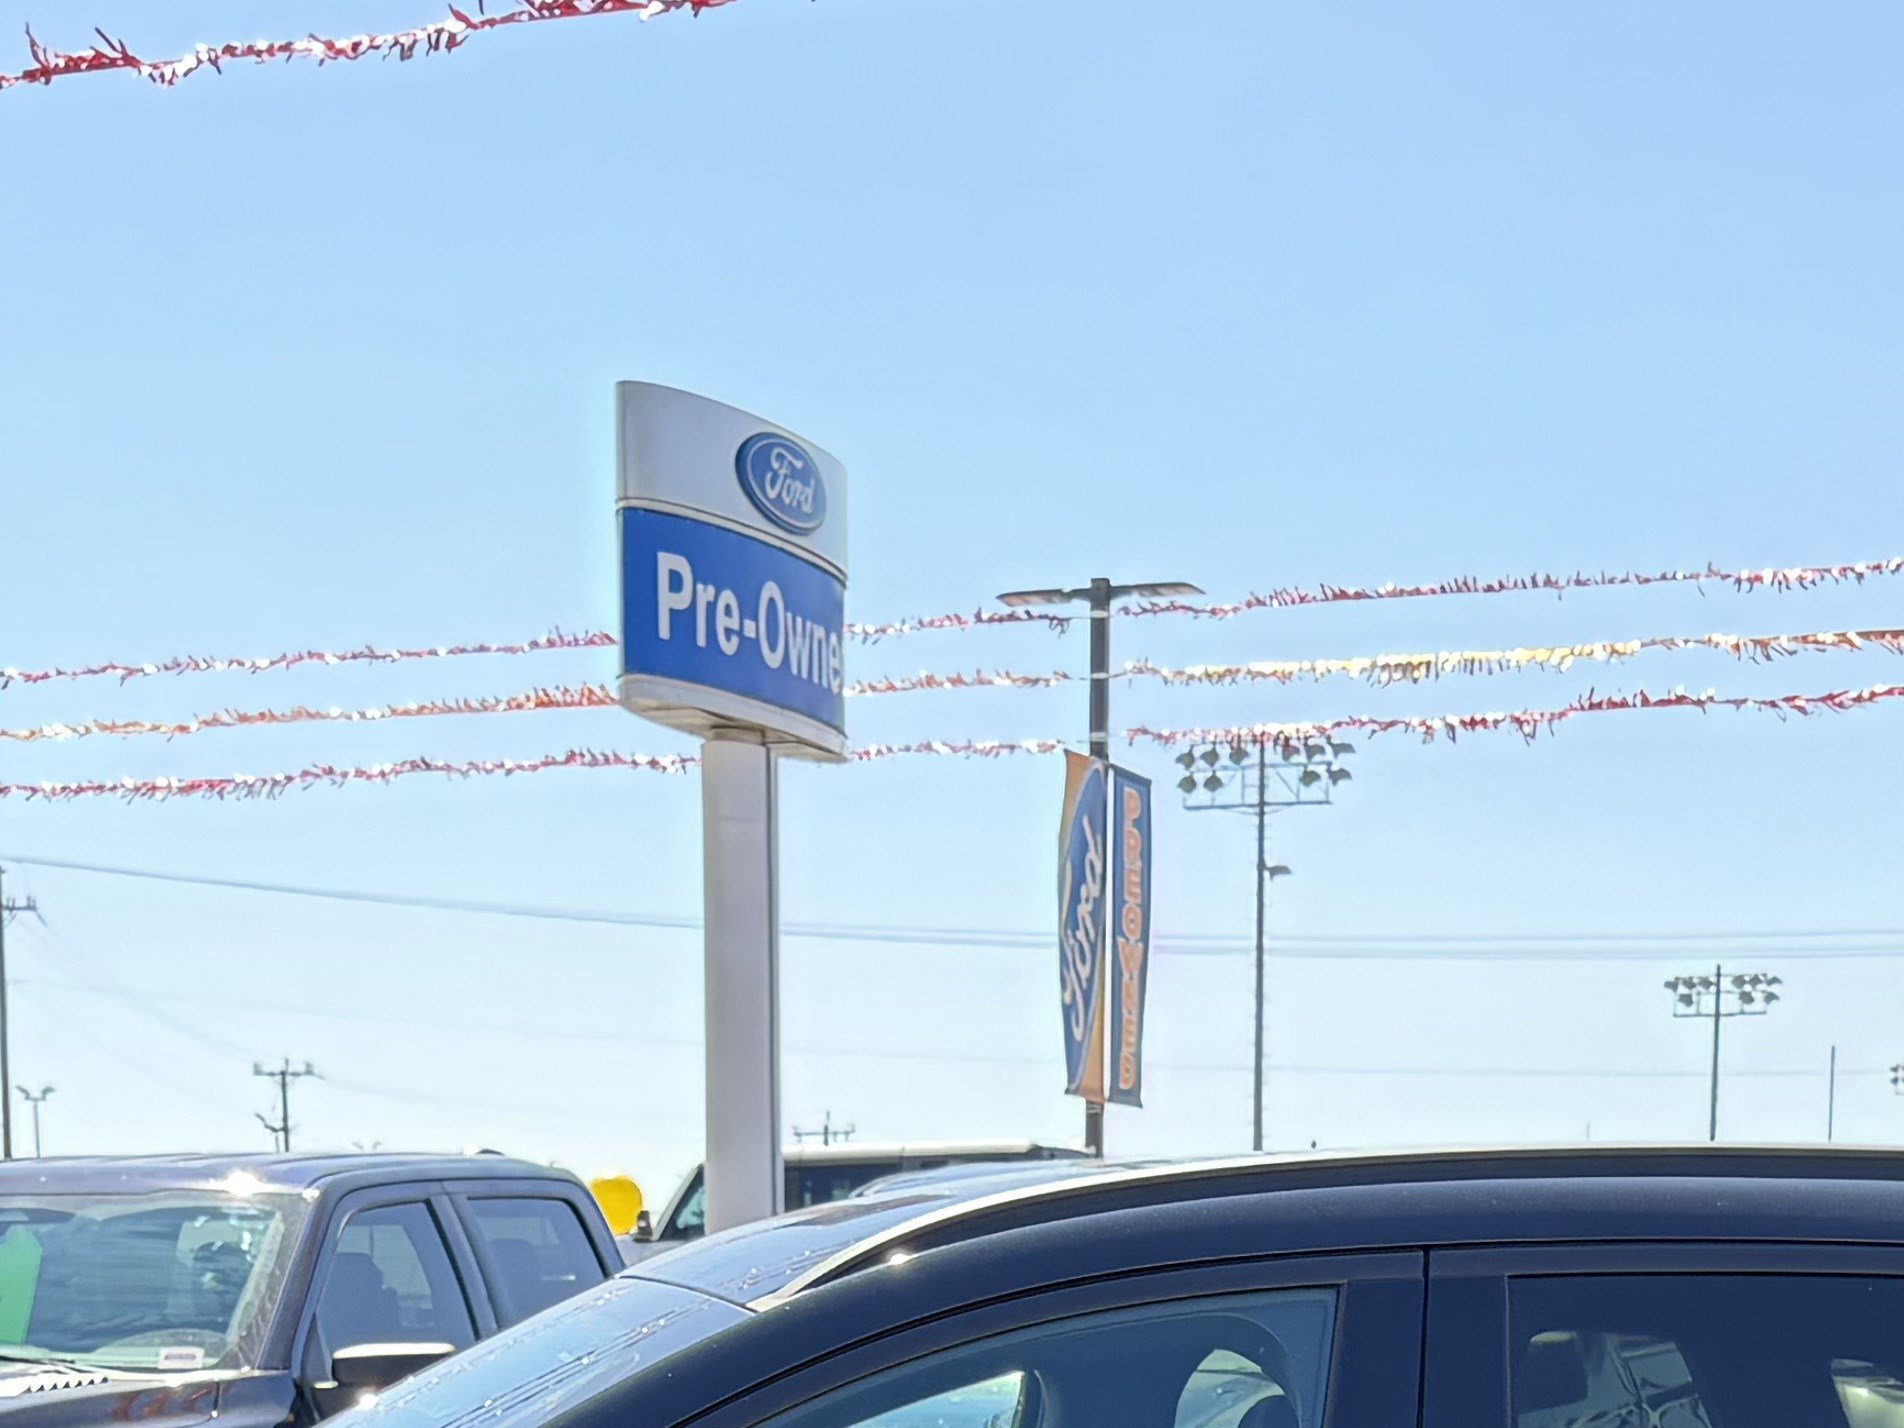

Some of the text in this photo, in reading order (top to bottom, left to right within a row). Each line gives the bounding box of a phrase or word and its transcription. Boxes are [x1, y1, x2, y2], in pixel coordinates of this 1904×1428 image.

[764, 446, 816, 514] Ford
[1062, 814, 1103, 1042] Ford
[1117, 786, 1144, 1090] PREOWNED
